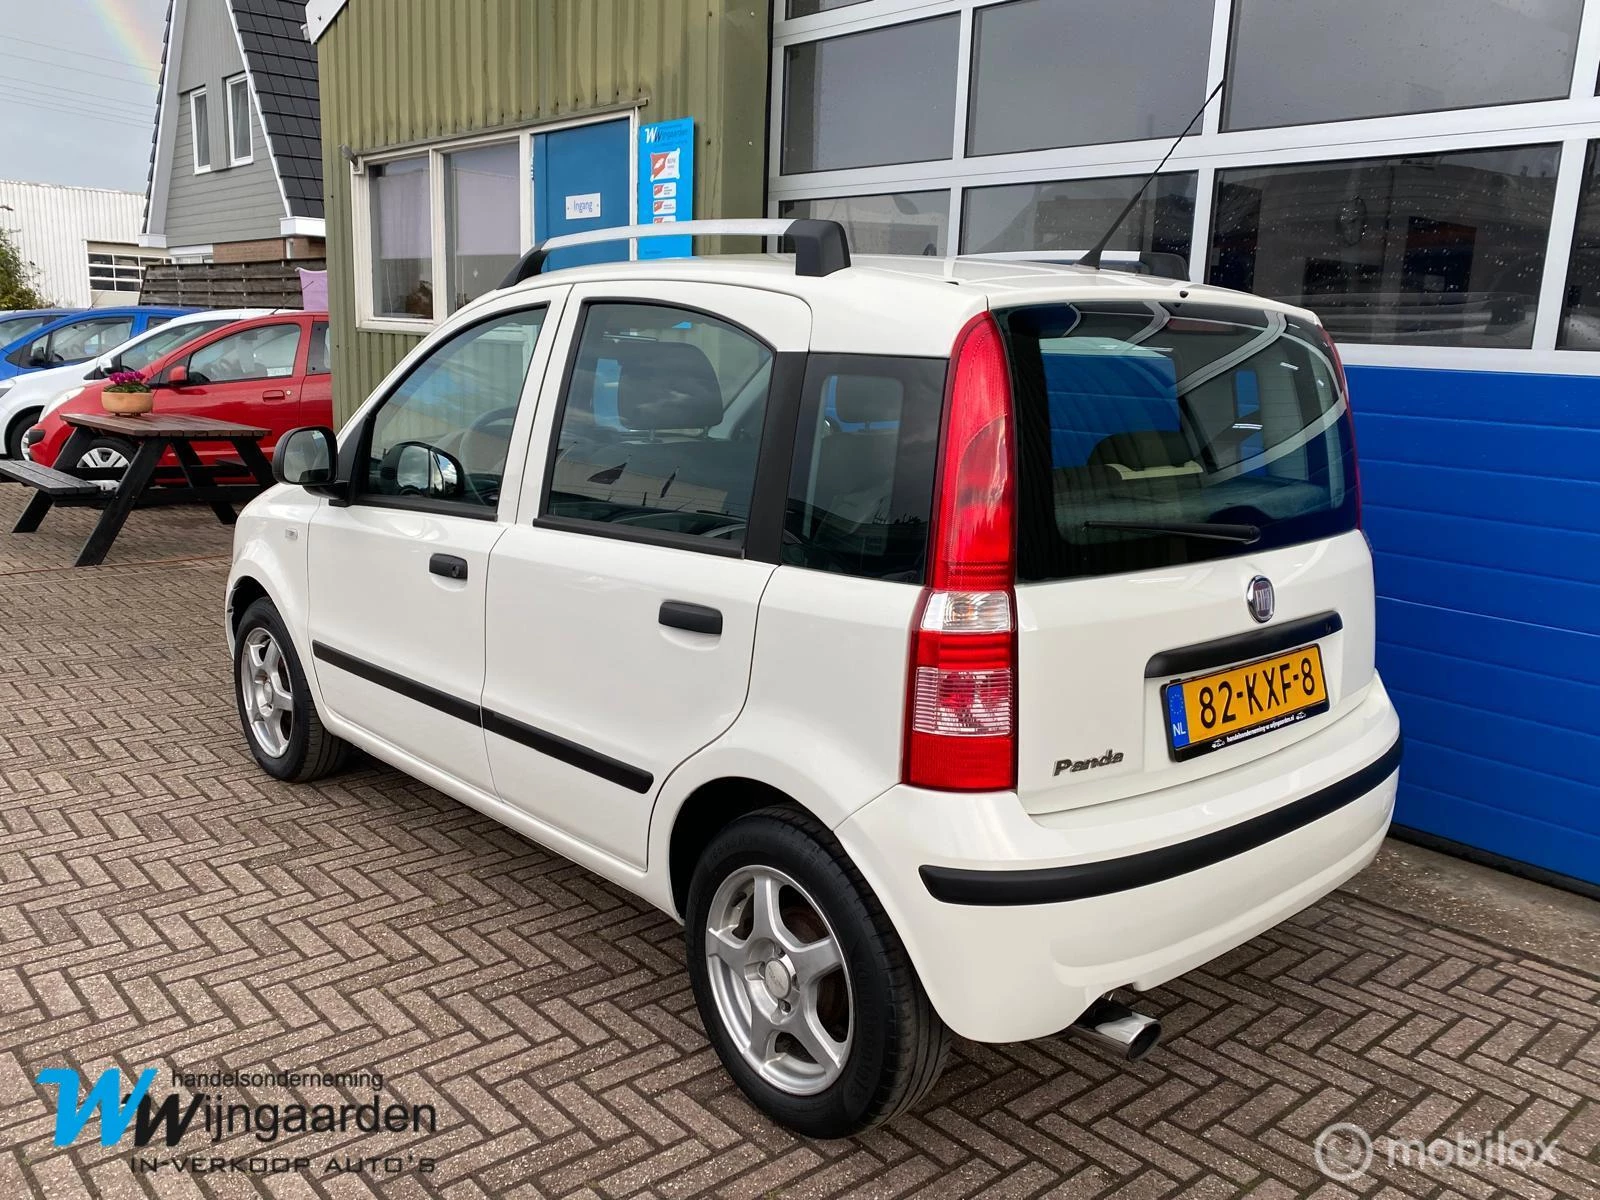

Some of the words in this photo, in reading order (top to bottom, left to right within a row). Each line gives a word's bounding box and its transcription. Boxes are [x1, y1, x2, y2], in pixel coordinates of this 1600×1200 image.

[573, 200, 593, 213] Ingang
[1199, 657, 1316, 729] 82-KXF-8
[1172, 722, 1187, 737] NL
[1052, 748, 1124, 777] Panda
